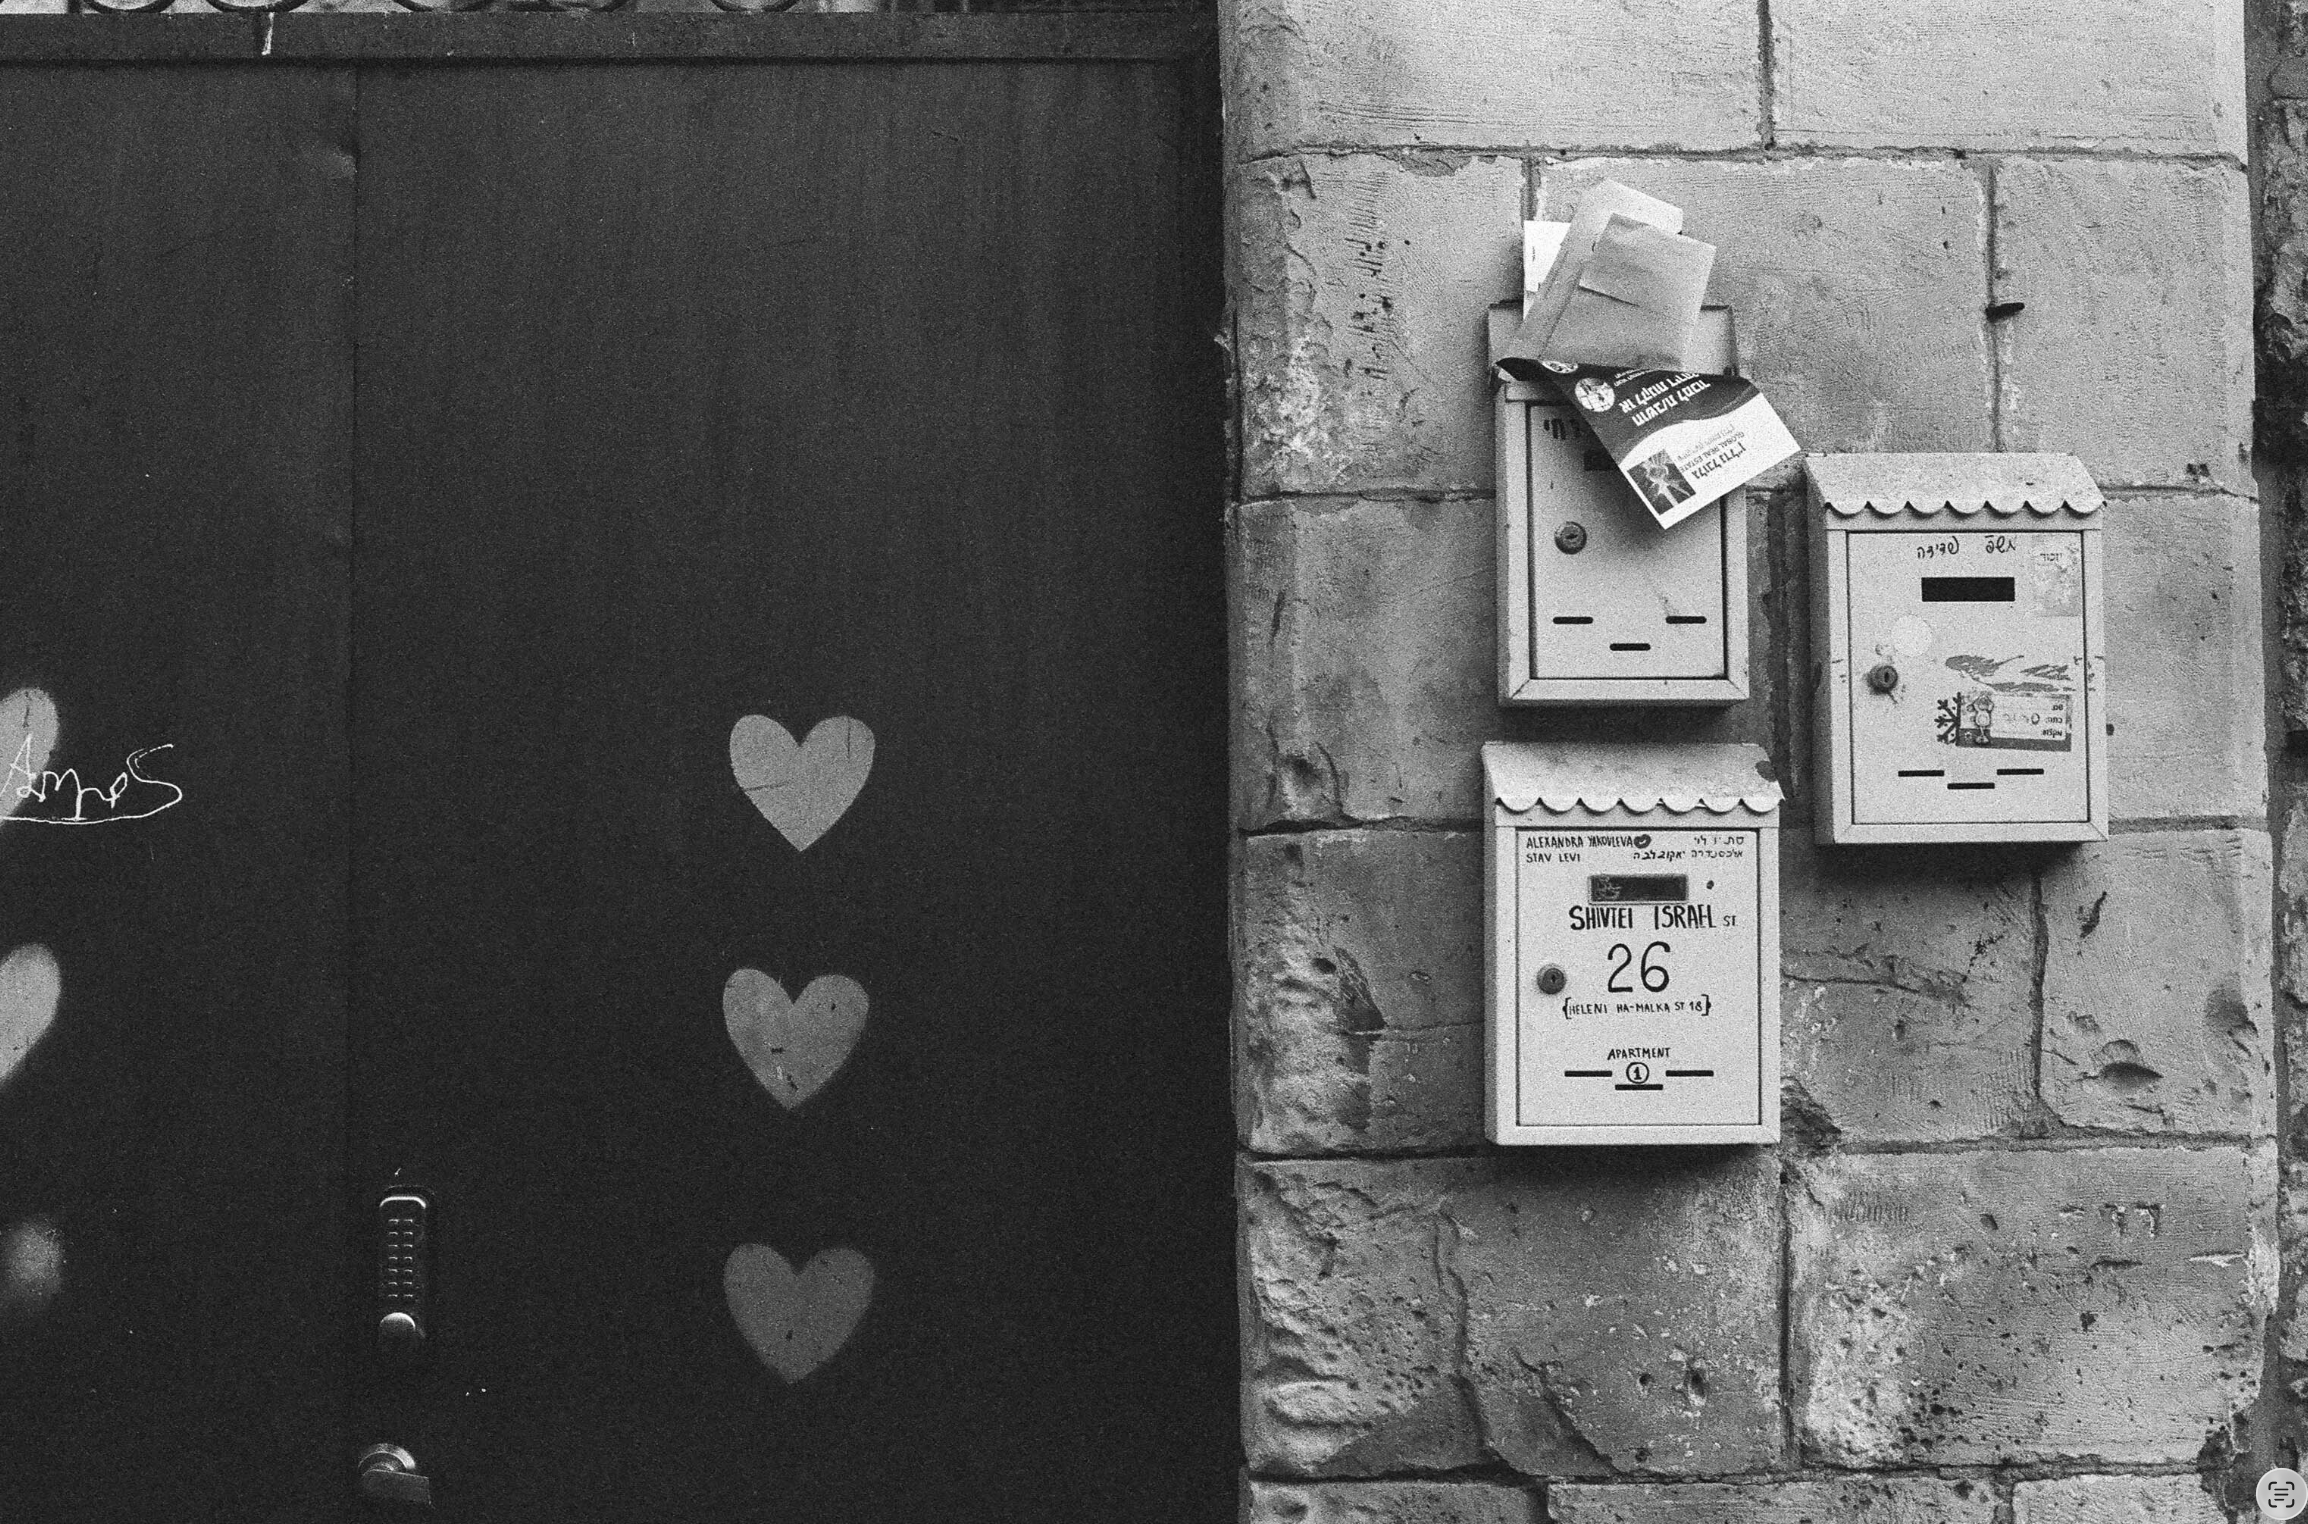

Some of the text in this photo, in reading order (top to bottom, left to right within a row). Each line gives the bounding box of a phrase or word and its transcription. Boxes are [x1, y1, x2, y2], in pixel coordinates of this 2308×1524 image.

[1635, 382, 1668, 405] לקנות
[1677, 380, 1710, 401] למכור
[1679, 433, 1744, 474] GLOBAL REAL ESTATE
[1693, 460, 1721, 478] גלובל
[1526, 836, 1584, 849] ALEXANDRA
[1526, 853, 1580, 863] STAV LEVI
[1569, 905, 1633, 930] SHIVTEI
[1654, 904, 1716, 930] ISRAEL
[1607, 941, 1671, 993] 26
[1616, 1002, 1670, 1014] HA-MALKA
[1675, 1001, 1685, 1011] ST
[1606, 1047, 1671, 1060] APARTMENT
